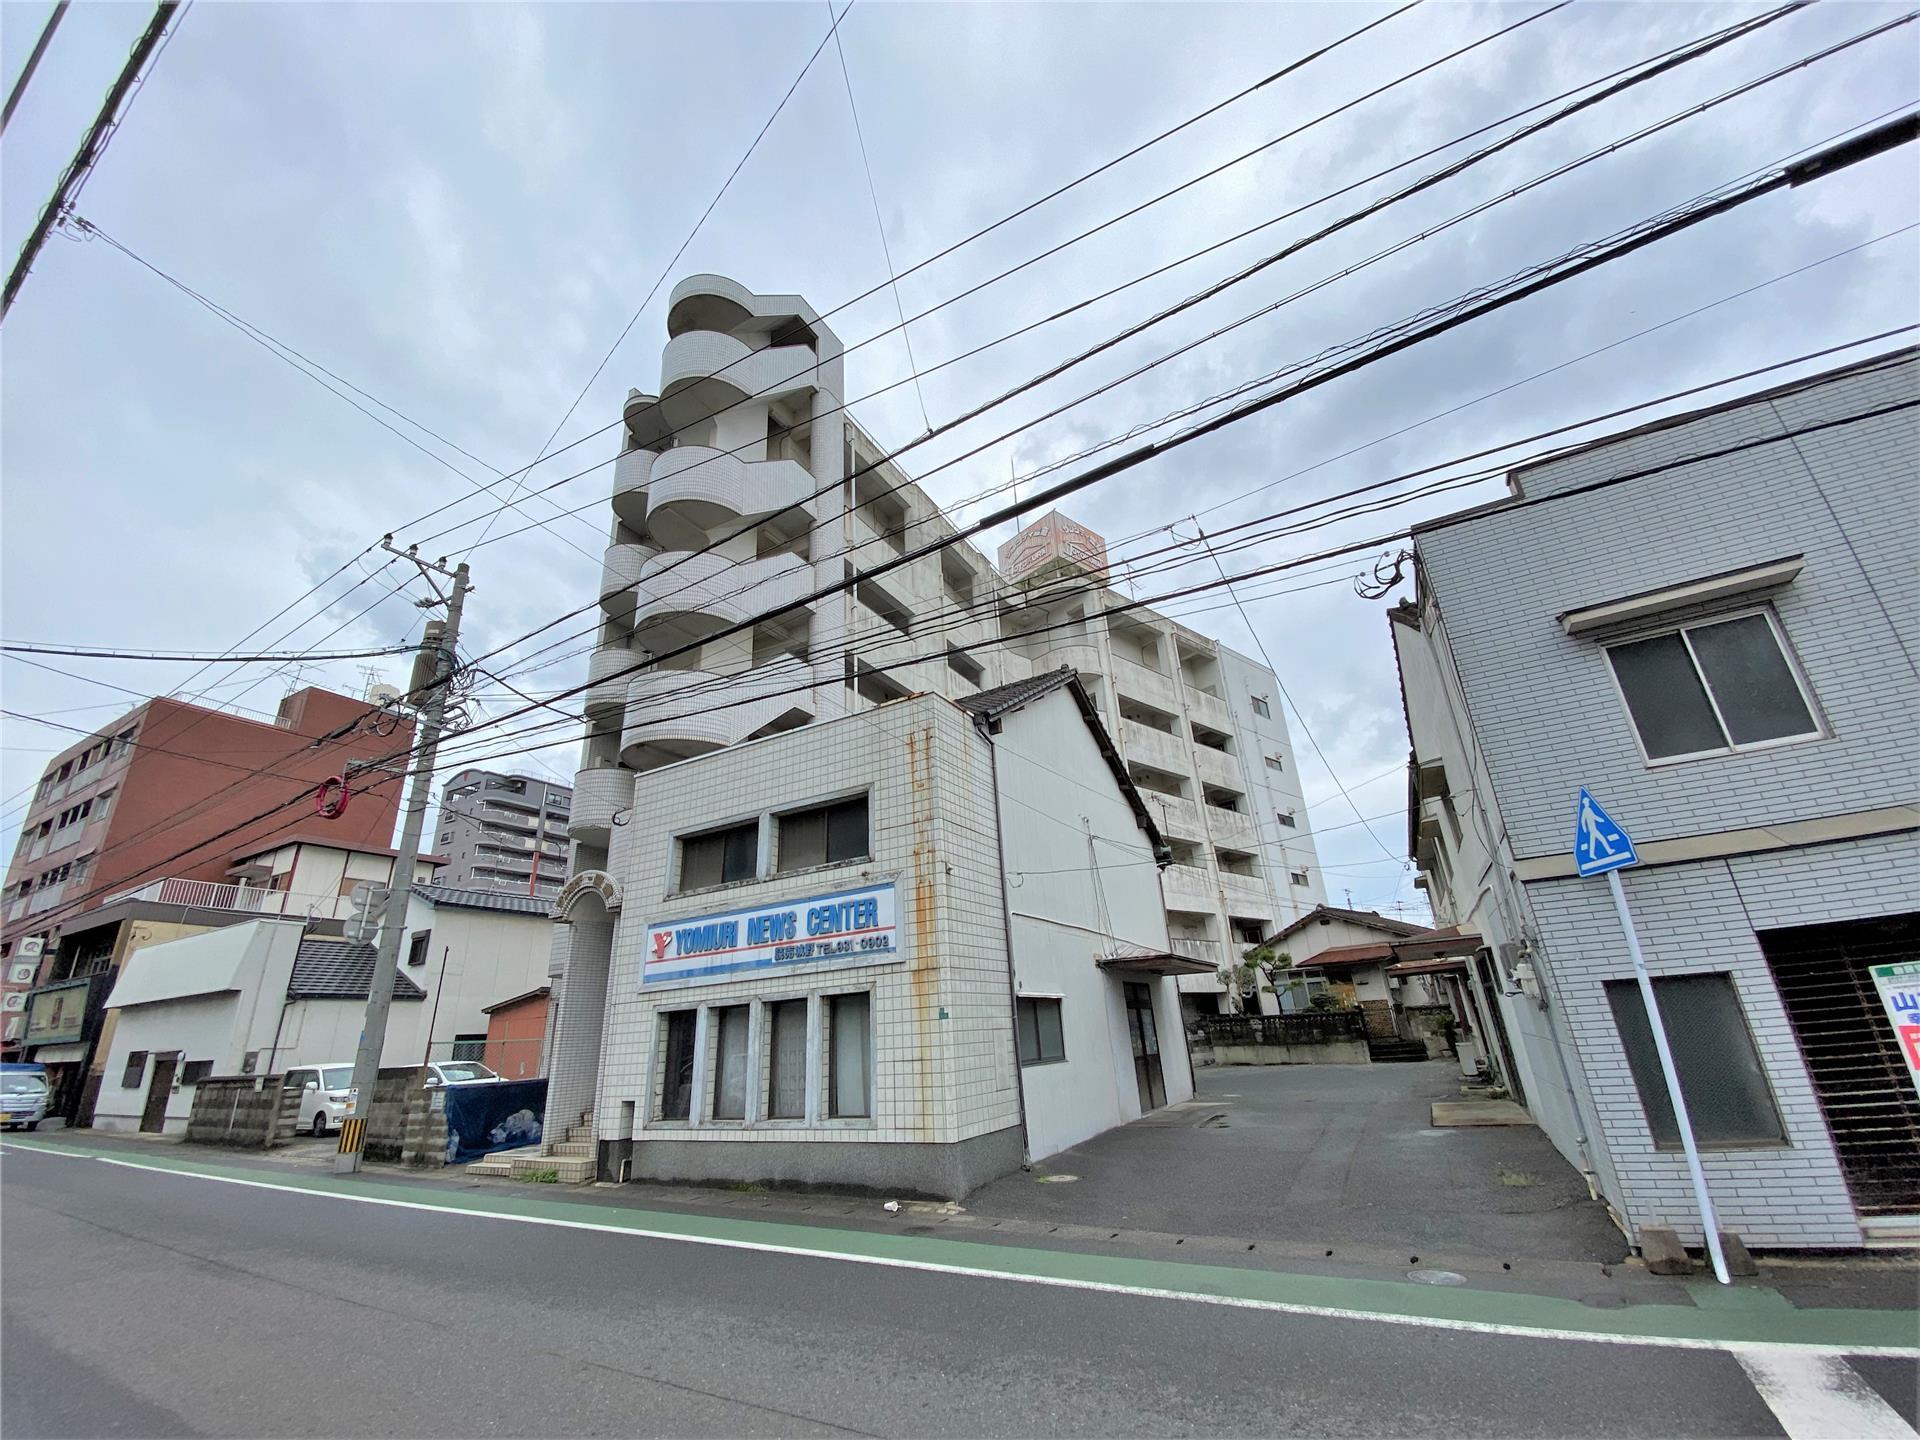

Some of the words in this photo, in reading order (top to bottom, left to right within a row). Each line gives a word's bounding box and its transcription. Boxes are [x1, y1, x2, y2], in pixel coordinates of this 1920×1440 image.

[675, 920, 739, 956] YOMIURI
[746, 911, 797, 946] NEWS
[807, 897, 879, 936] CENTER
